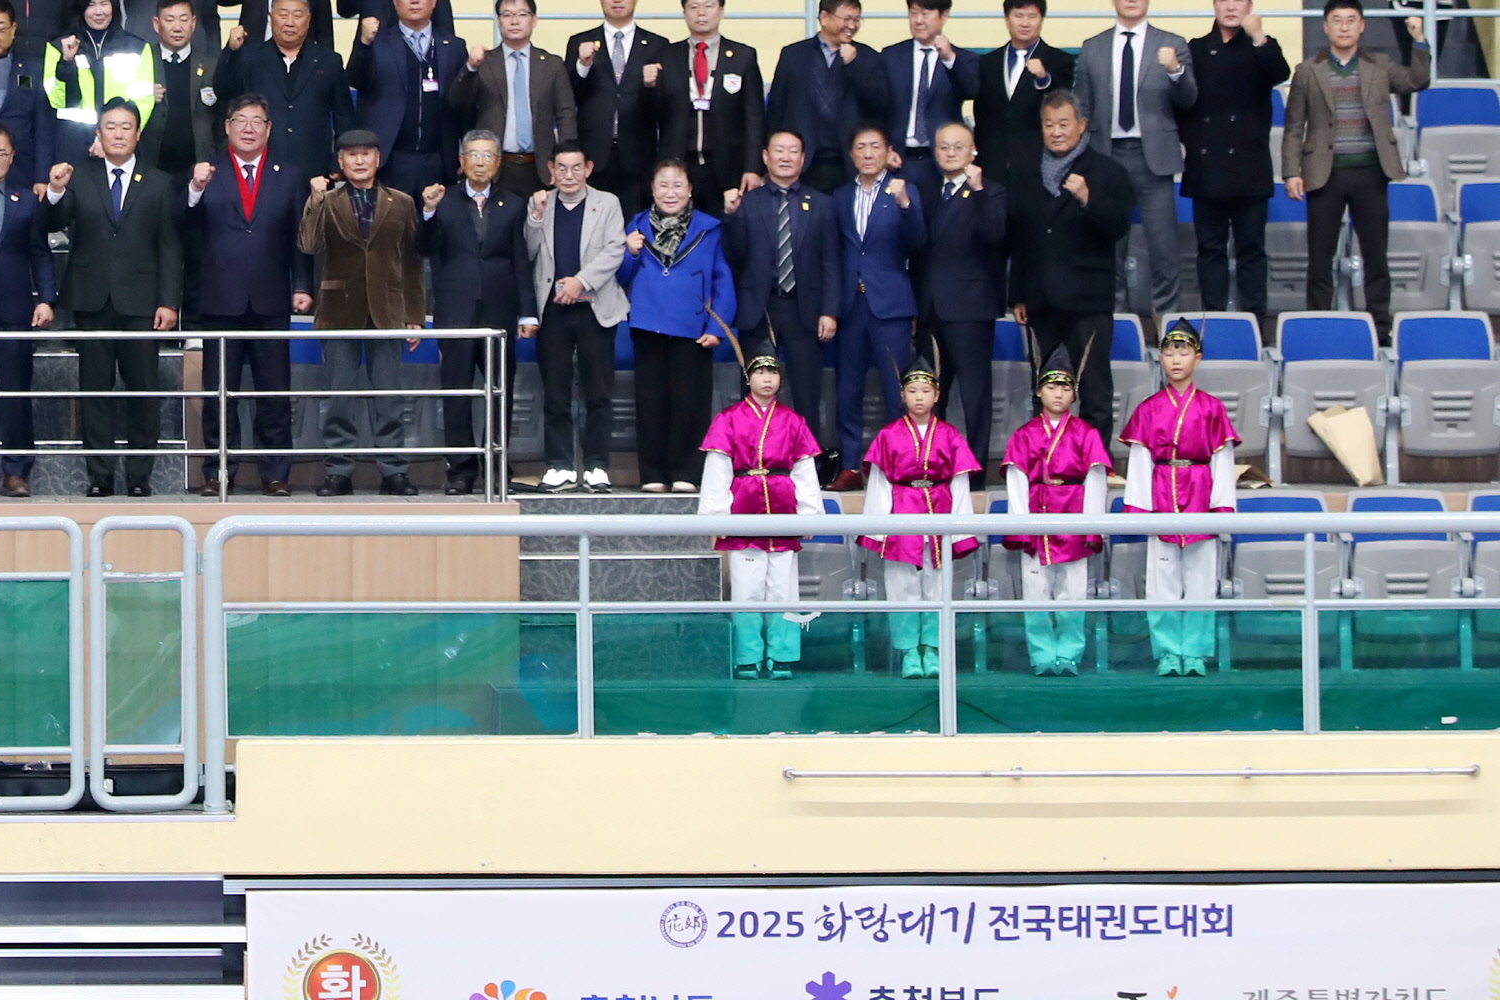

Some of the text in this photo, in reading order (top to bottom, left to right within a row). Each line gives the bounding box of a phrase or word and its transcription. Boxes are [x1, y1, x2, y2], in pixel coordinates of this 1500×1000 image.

[717, 901, 1235, 946] 2025 화랑대기 전국태권도대회
